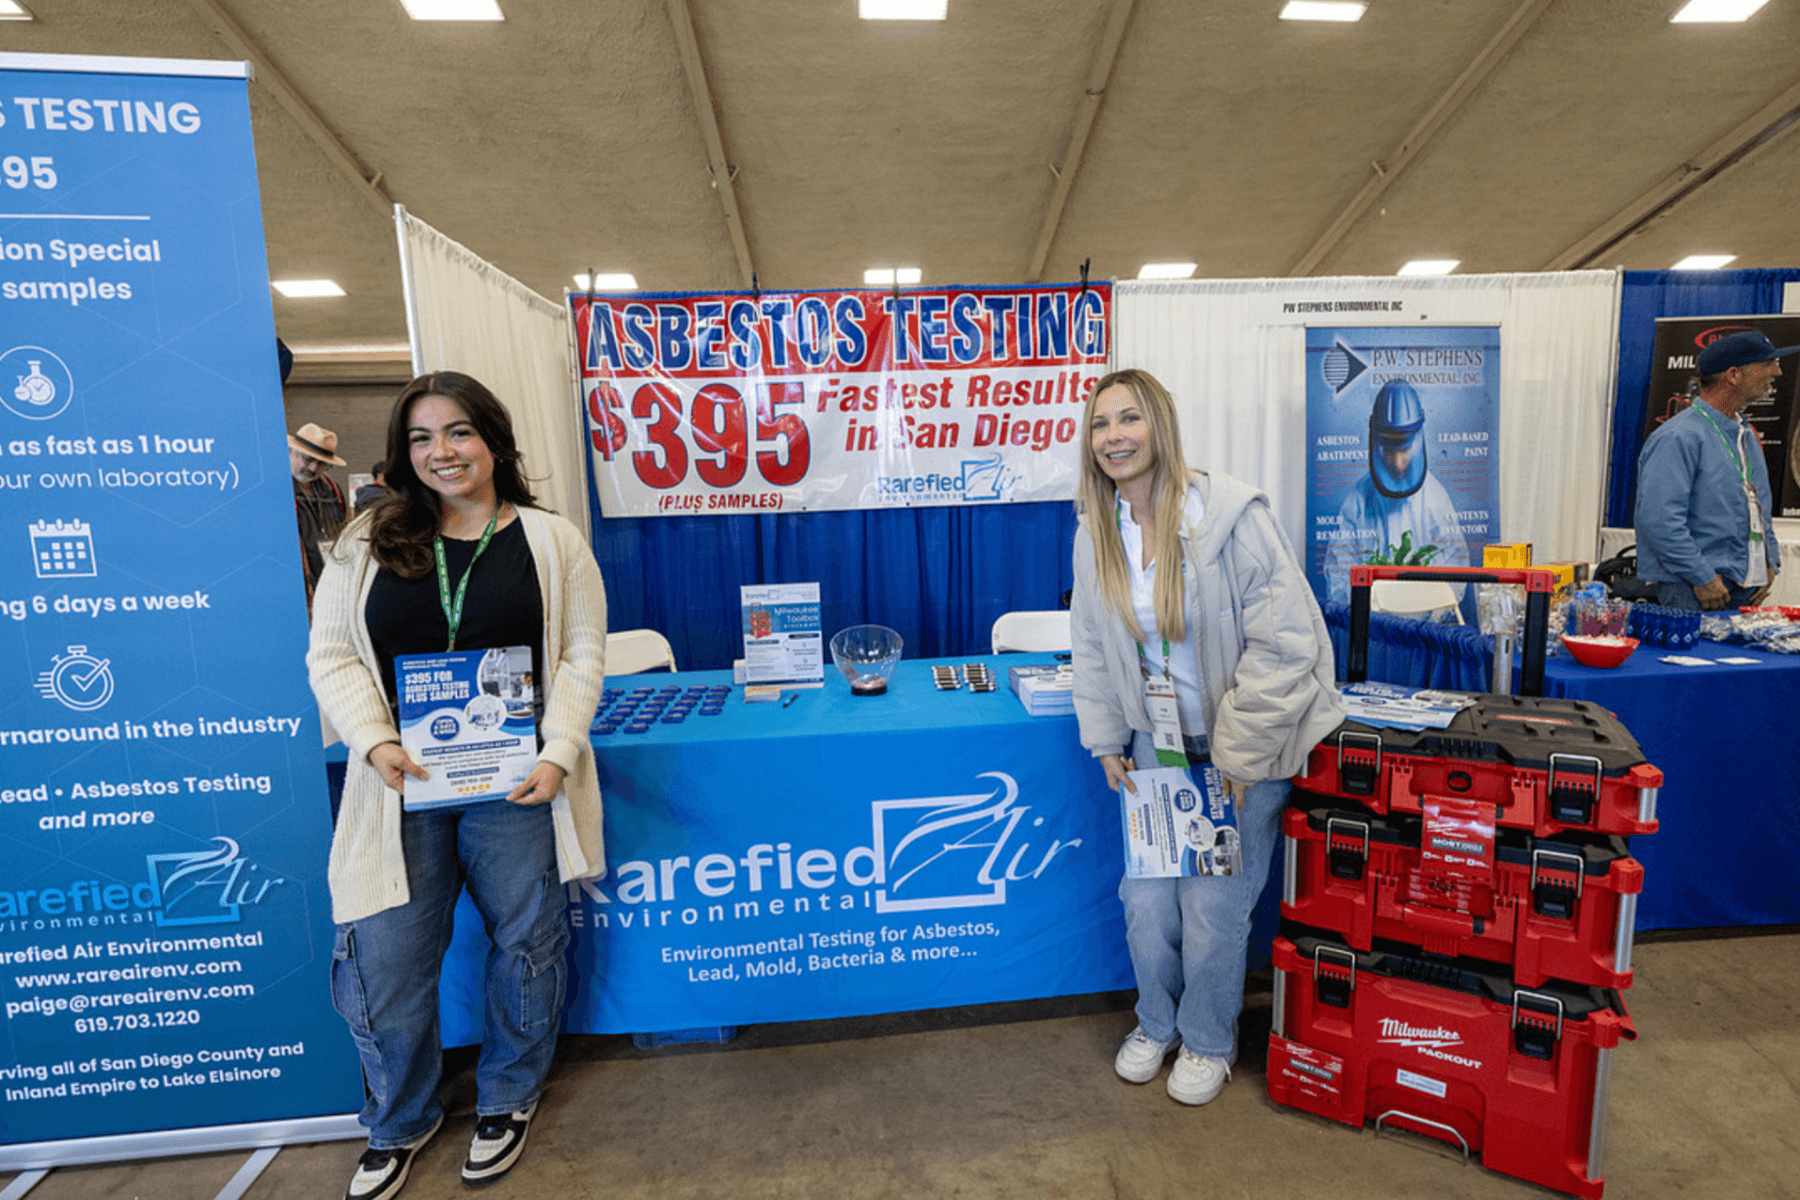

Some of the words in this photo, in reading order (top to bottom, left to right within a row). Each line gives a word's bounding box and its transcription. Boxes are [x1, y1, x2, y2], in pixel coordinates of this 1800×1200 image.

[14, 97, 201, 134] TESTING
[0, 155, 58, 189] 95
[49, 238, 161, 267] Special
[3, 277, 132, 306] samples
[1297, 301, 1333, 313] STEPHENS
[1334, 301, 1389, 312] ENVIRONMENTAL
[587, 295, 868, 372] ASBESTOS
[884, 289, 1105, 364] TESTING
[1373, 350, 1402, 367] P.W.
[1406, 350, 1483, 367] STEPHENS
[817, 374, 954, 414] Fastest
[967, 369, 1097, 409] Results
[9, 440, 42, 456] as
[46, 435, 97, 456] fast
[102, 437, 134, 455] as
[138, 435, 149, 454] 1
[154, 434, 215, 454] hour
[588, 381, 811, 490] $395
[845, 418, 877, 451] in
[899, 418, 959, 449] San
[973, 414, 1076, 452] Diego
[1316, 435, 1360, 446] ASBESTOS
[1438, 432, 1489, 443] LEAD-BASED
[1316, 449, 1370, 462] ABATEMENT
[1464, 446, 1488, 458] PAINT
[40, 473, 92, 489] own
[98, 461, 240, 492] laboratory)
[877, 473, 966, 494] Rarefied
[658, 493, 703, 513] (PLUS
[708, 491, 783, 511] SAMPLES)
[1315, 516, 1344, 526] MOLD
[1446, 511, 1489, 521] CONTENTS
[32, 595, 48, 614] 6
[53, 593, 116, 618] days
[121, 596, 138, 611] a
[143, 591, 211, 611] week
[404, 671, 432, 685] $395
[433, 670, 453, 682] FOR
[405, 692, 428, 704] PLUS
[430, 689, 470, 701] SAMPLES
[124, 720, 148, 739] in
[153, 719, 194, 738] the
[199, 715, 302, 737] industry
[0, 783, 49, 804] ead
[71, 777, 179, 800] Asbestos
[184, 773, 271, 794] Testing
[39, 810, 86, 830] and
[92, 809, 155, 827] more
[892, 805, 1083, 894] Air
[165, 857, 285, 911] Air
[570, 890, 872, 928] Environmental
[73, 941, 103, 959] Air
[108, 930, 263, 957] Environmental
[661, 936, 802, 964] Environmental
[811, 928, 876, 951] Testing
[880, 925, 908, 943] for
[912, 919, 1001, 940] Asbestos,
[15, 957, 242, 989] www.rareairenv.com
[688, 964, 741, 983] Lead,
[745, 956, 802, 978] Mold,
[808, 949, 888, 972] Bacteria
[891, 947, 907, 963] &
[911, 944, 978, 961] more...
[5, 982, 255, 1019] paige@rareairenv.com
[74, 1009, 201, 1034] 619.703.1220
[1377, 1017, 1461, 1040] Milwaukee
[51, 1060, 76, 1076] all
[78, 1057, 97, 1073] of
[101, 1055, 137, 1072] San
[141, 1051, 194, 1069] Diego
[197, 1046, 264, 1068] County
[268, 1041, 304, 1058] and
[1417, 1047, 1482, 1069] PACKOUT
[5, 1082, 67, 1102] Inland
[71, 1077, 137, 1097] Empire
[139, 1074, 160, 1090] to
[163, 1070, 206, 1089] Lake
[210, 1065, 281, 1084] Elsinore
